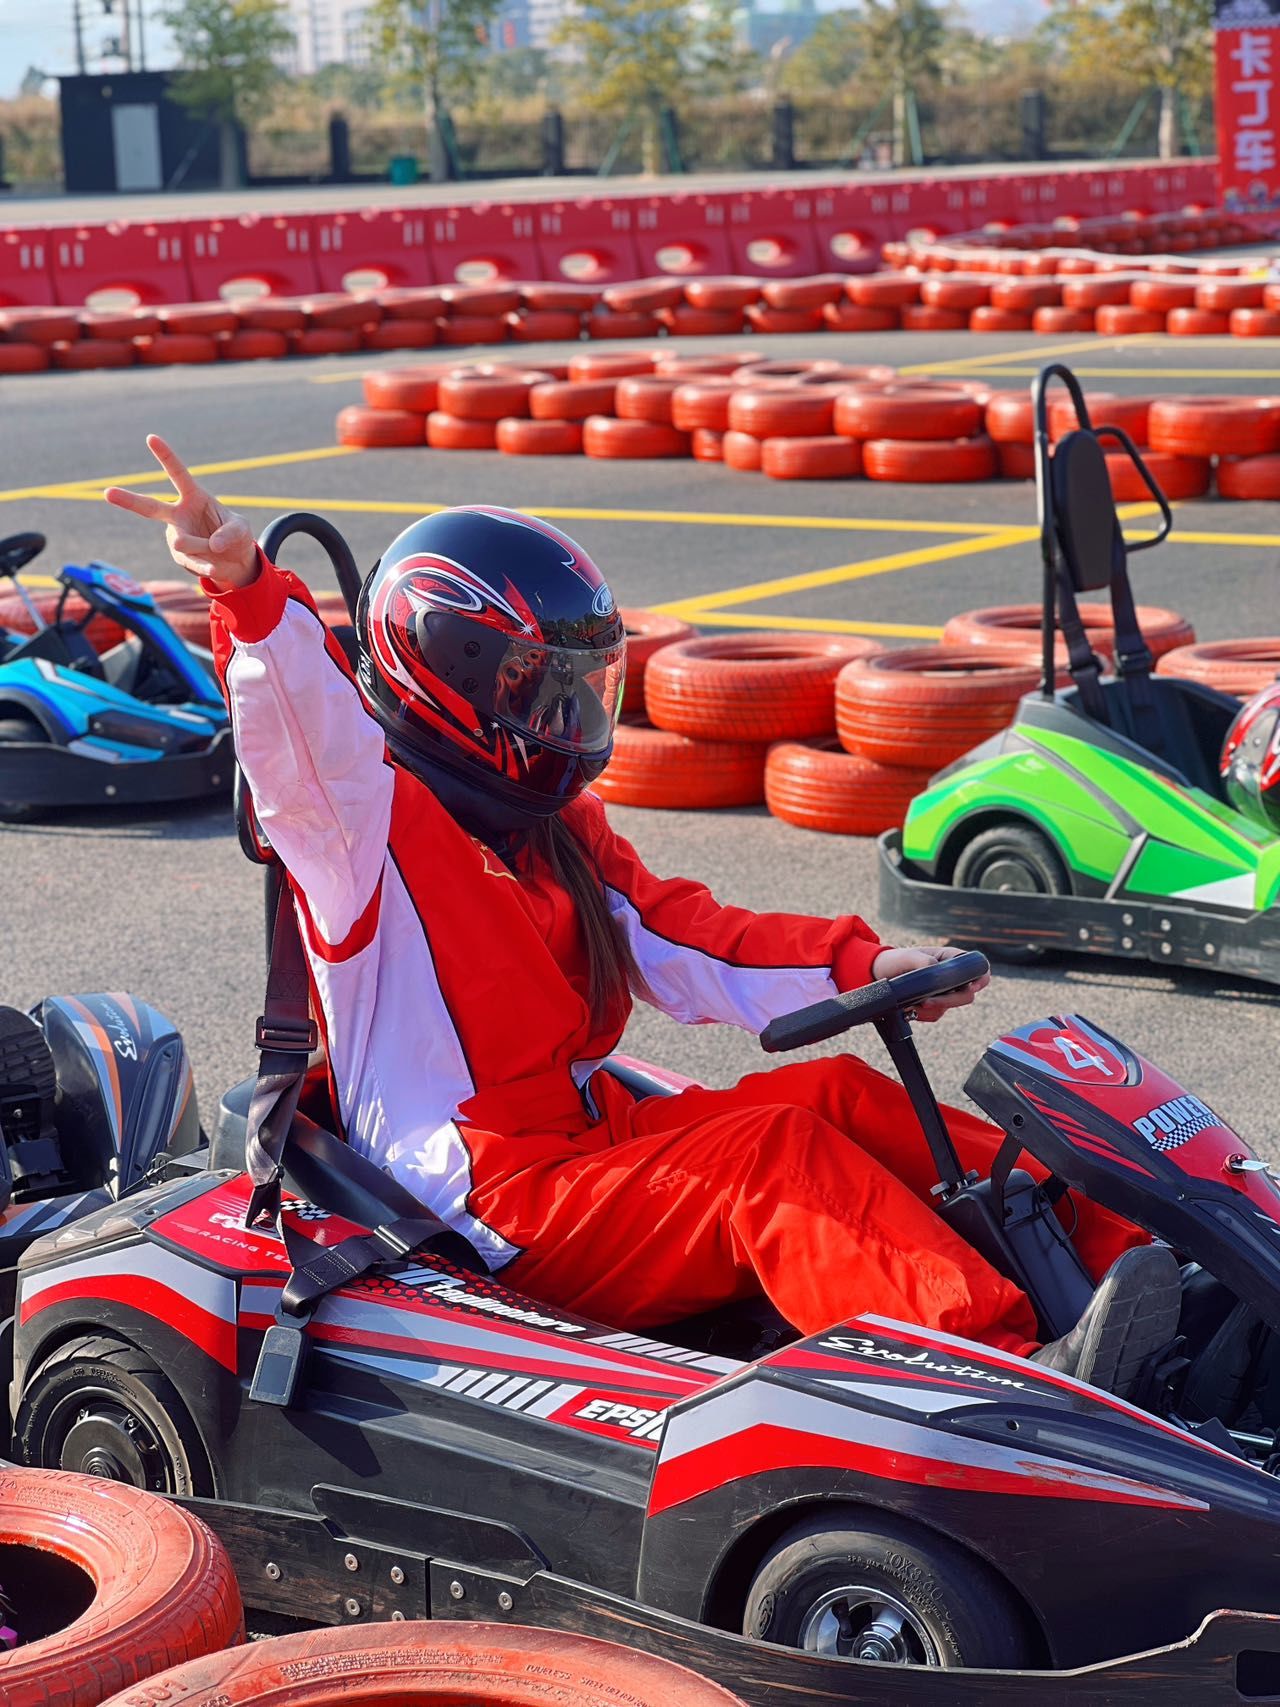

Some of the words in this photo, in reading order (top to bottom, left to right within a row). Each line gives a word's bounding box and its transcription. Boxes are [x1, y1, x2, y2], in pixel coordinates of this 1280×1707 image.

[1230, 31, 1276, 173] 卡丁车
[1053, 1036, 1114, 1076] 4
[196, 1230, 260, 1253] RACING
[818, 1336, 1066, 1400] Evolution
